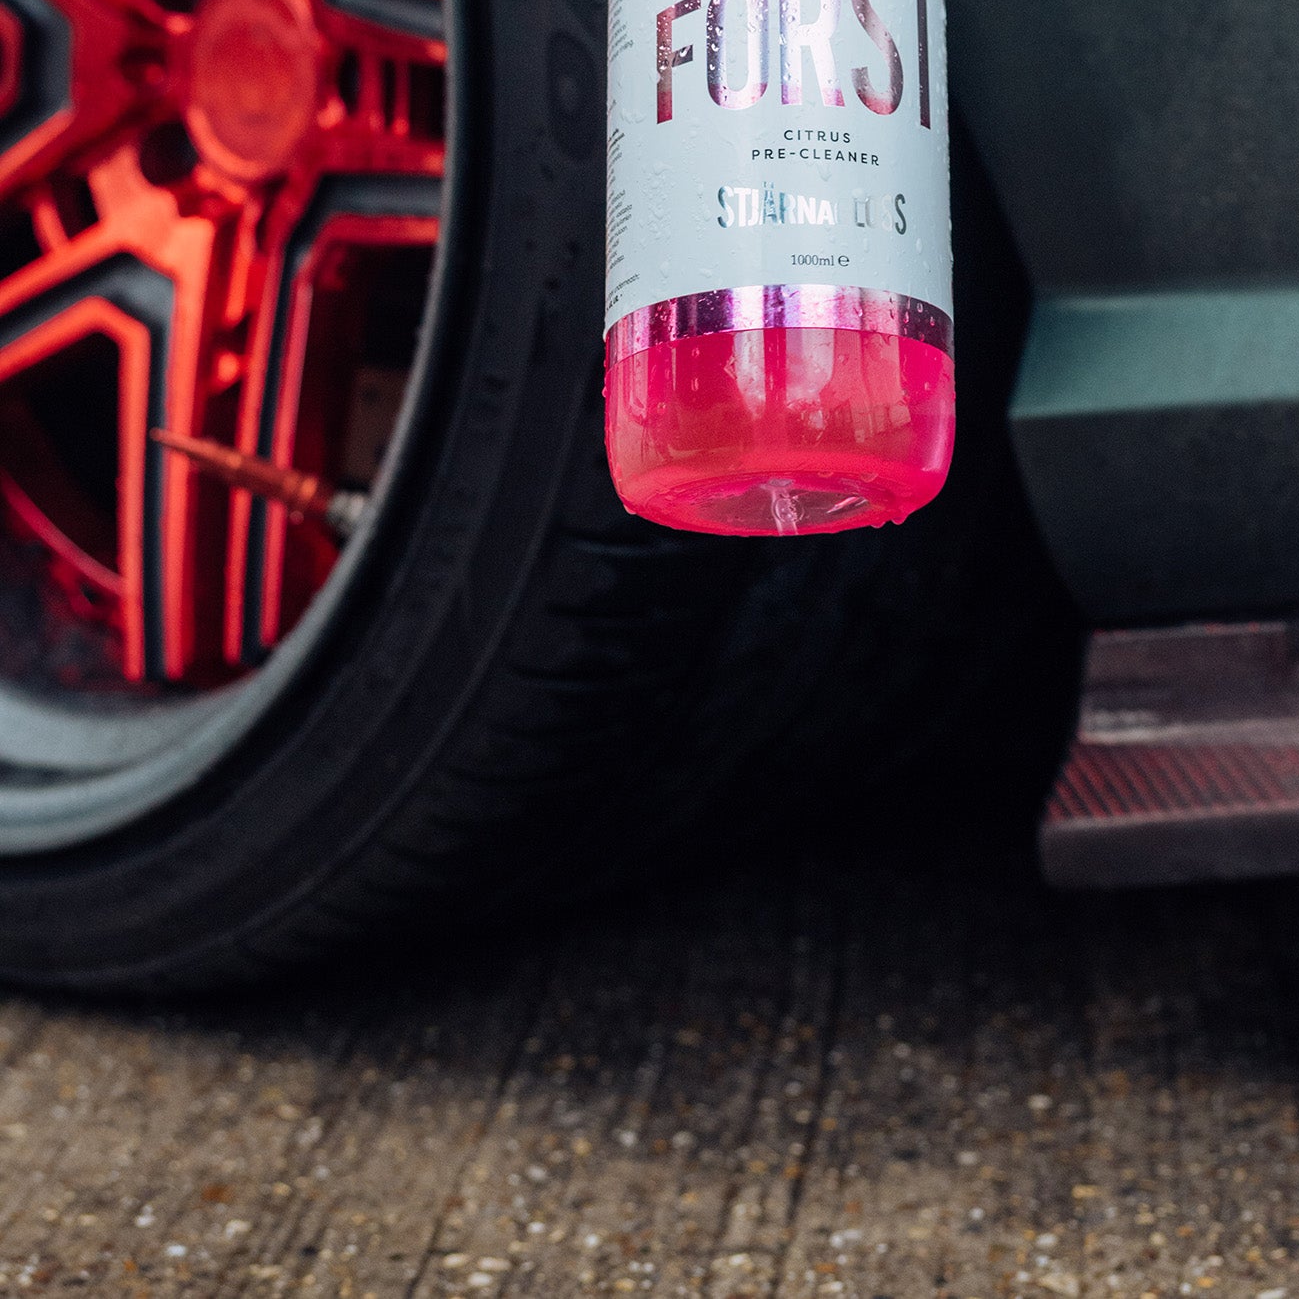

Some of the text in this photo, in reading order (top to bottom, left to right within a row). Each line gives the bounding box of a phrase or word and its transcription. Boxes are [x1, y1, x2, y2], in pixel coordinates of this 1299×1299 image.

[783, 129, 851, 144] CITRUS
[751, 148, 880, 166] PRE-CLEANER
[791, 254, 835, 267] 1000ml
